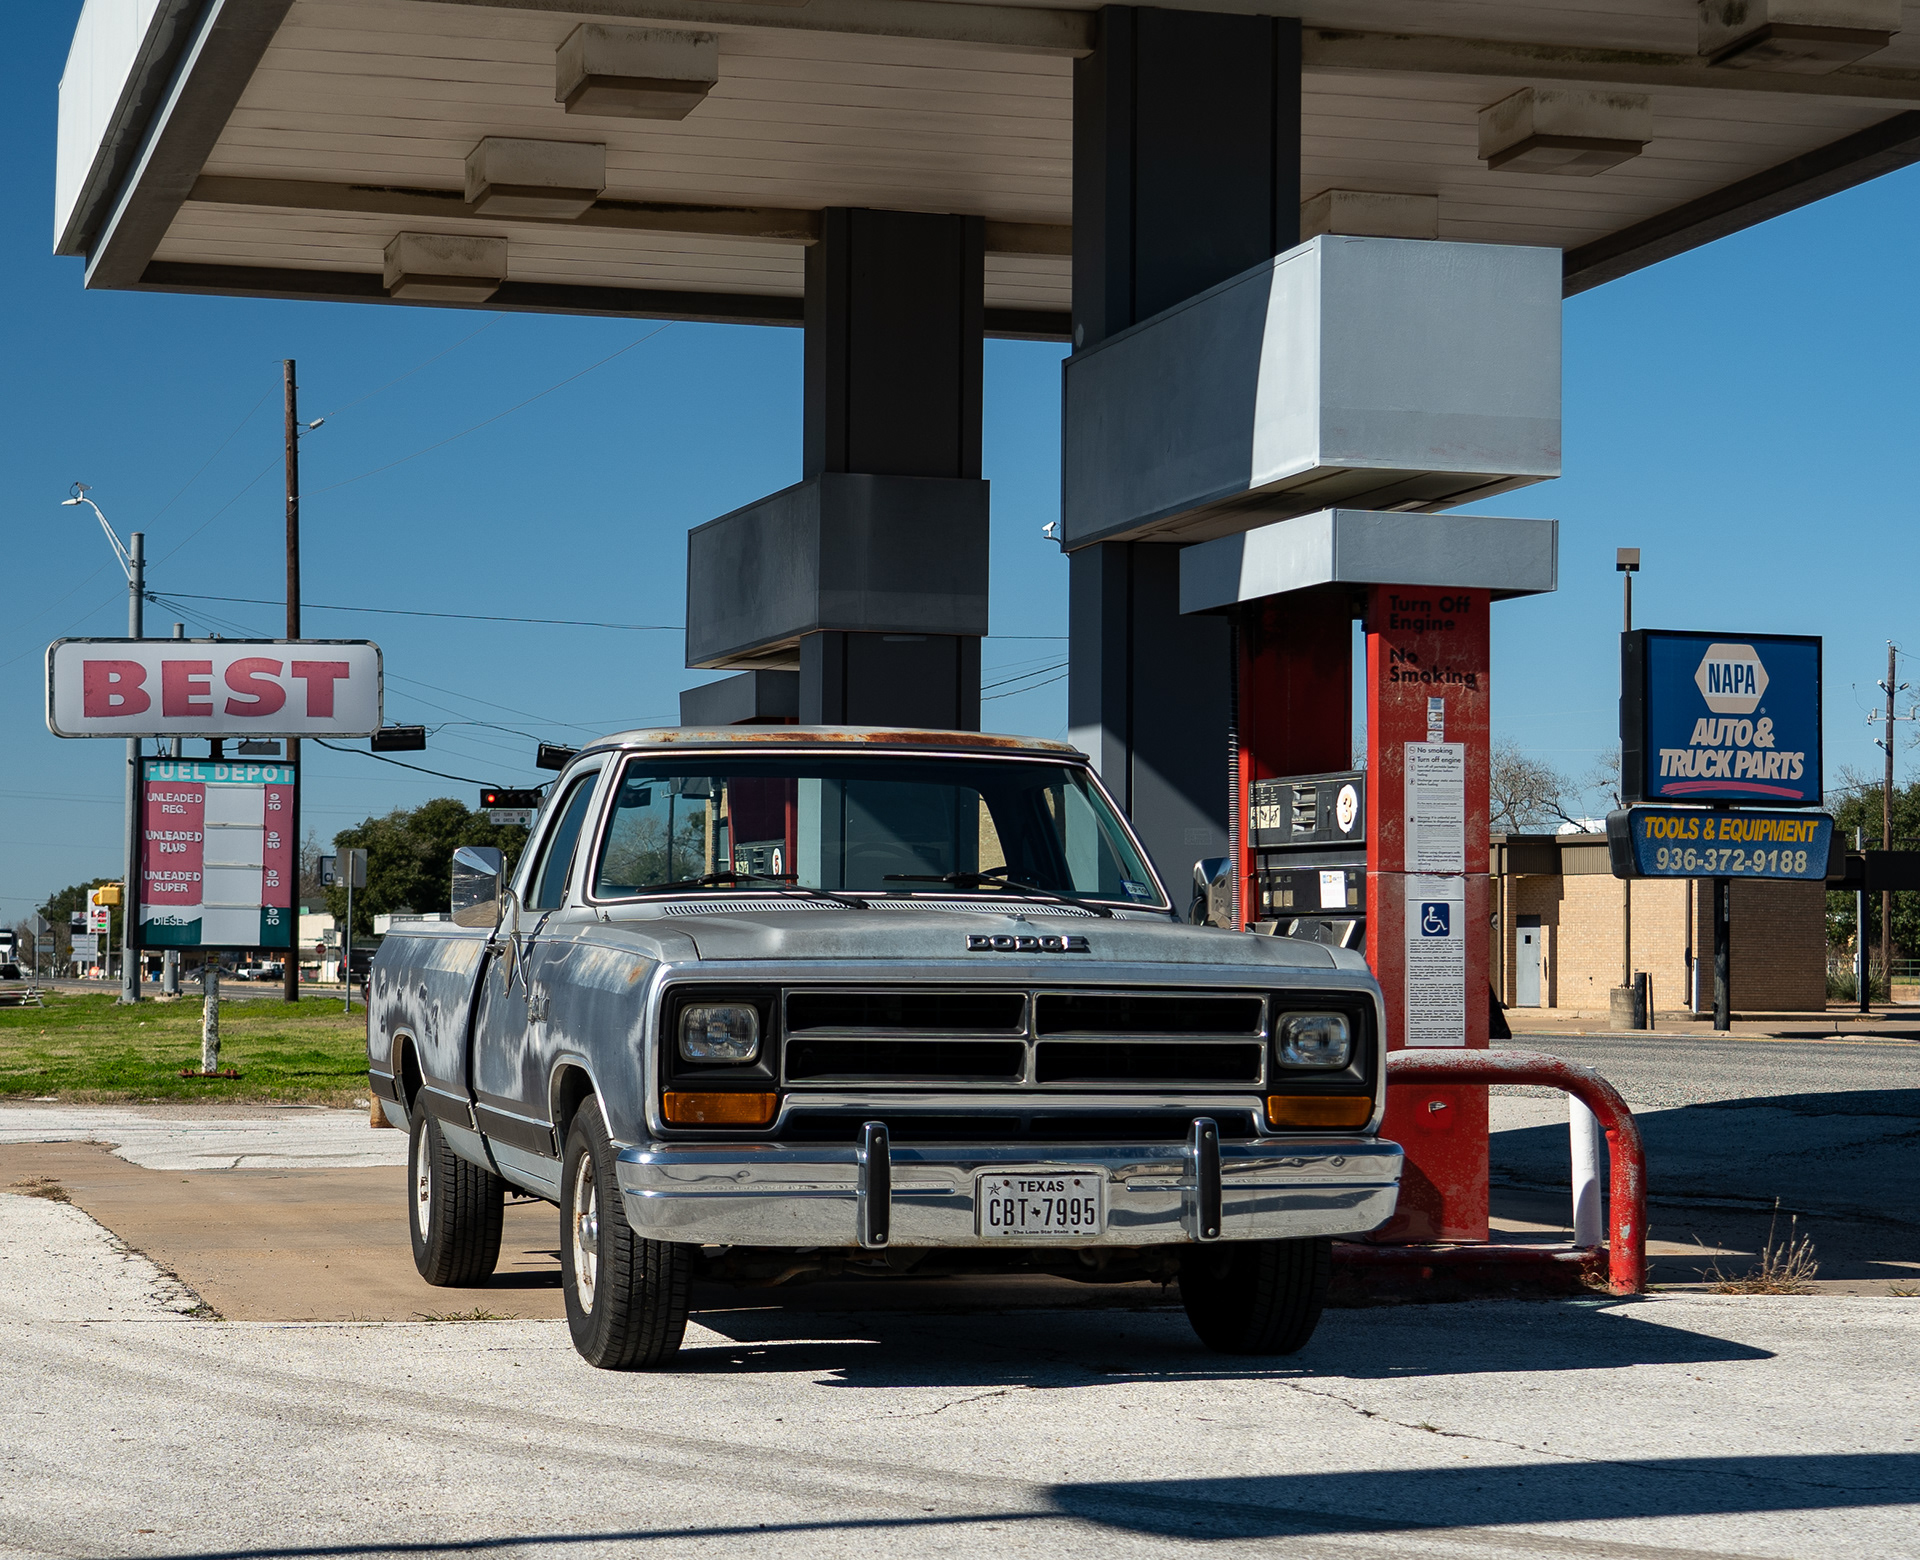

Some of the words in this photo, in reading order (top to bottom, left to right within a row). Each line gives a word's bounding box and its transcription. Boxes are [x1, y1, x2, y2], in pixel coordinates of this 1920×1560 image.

[1389, 595, 1431, 611] Turn
[1439, 596, 1471, 613] Off
[1389, 613, 1455, 635] Engine
[1390, 648, 1418, 663] No
[1389, 665, 1476, 688] Smoking
[1708, 663, 1756, 695] NAPA
[83, 656, 350, 718] BEST
[1689, 718, 1754, 747] AUTO
[1753, 717, 1775, 748] &
[1428, 746, 1453, 756] smoking
[1431, 755, 1440, 763] off
[1441, 756, 1461, 765] engine
[1659, 748, 1734, 779] TRUCK
[1734, 751, 1805, 780] PARTS
[144, 761, 206, 780] FUEL
[214, 763, 295, 783] DEPOT
[147, 792, 203, 803] UNLEADED
[269, 793, 280, 801] 9
[161, 804, 187, 815] REG.
[268, 803, 281, 811] 10
[1342, 793, 1352, 825] 3
[145, 830, 203, 842] UNLEADED
[268, 831, 279, 839] 9
[1644, 816, 1700, 840] TOOLS
[1702, 818, 1716, 841] &
[1718, 818, 1819, 844] EQUIPMENT
[159, 842, 187, 853] PLUS
[266, 841, 280, 849] 10
[775, 855, 779, 873] 5
[1656, 847, 1808, 873] 936-372-9188
[144, 870, 202, 882] UNLEADED
[267, 870, 278, 878] 9
[153, 882, 189, 893] SUPER
[265, 879, 280, 888] 10
[268, 908, 279, 916] 9
[153, 916, 189, 926] DIESEL
[265, 918, 280, 926] 10
[966, 934, 1090, 952] DODGE
[1018, 1180, 1065, 1192] TEXAS
[989, 1198, 1029, 1227] CBT
[1042, 1198, 1095, 1226] 7995
